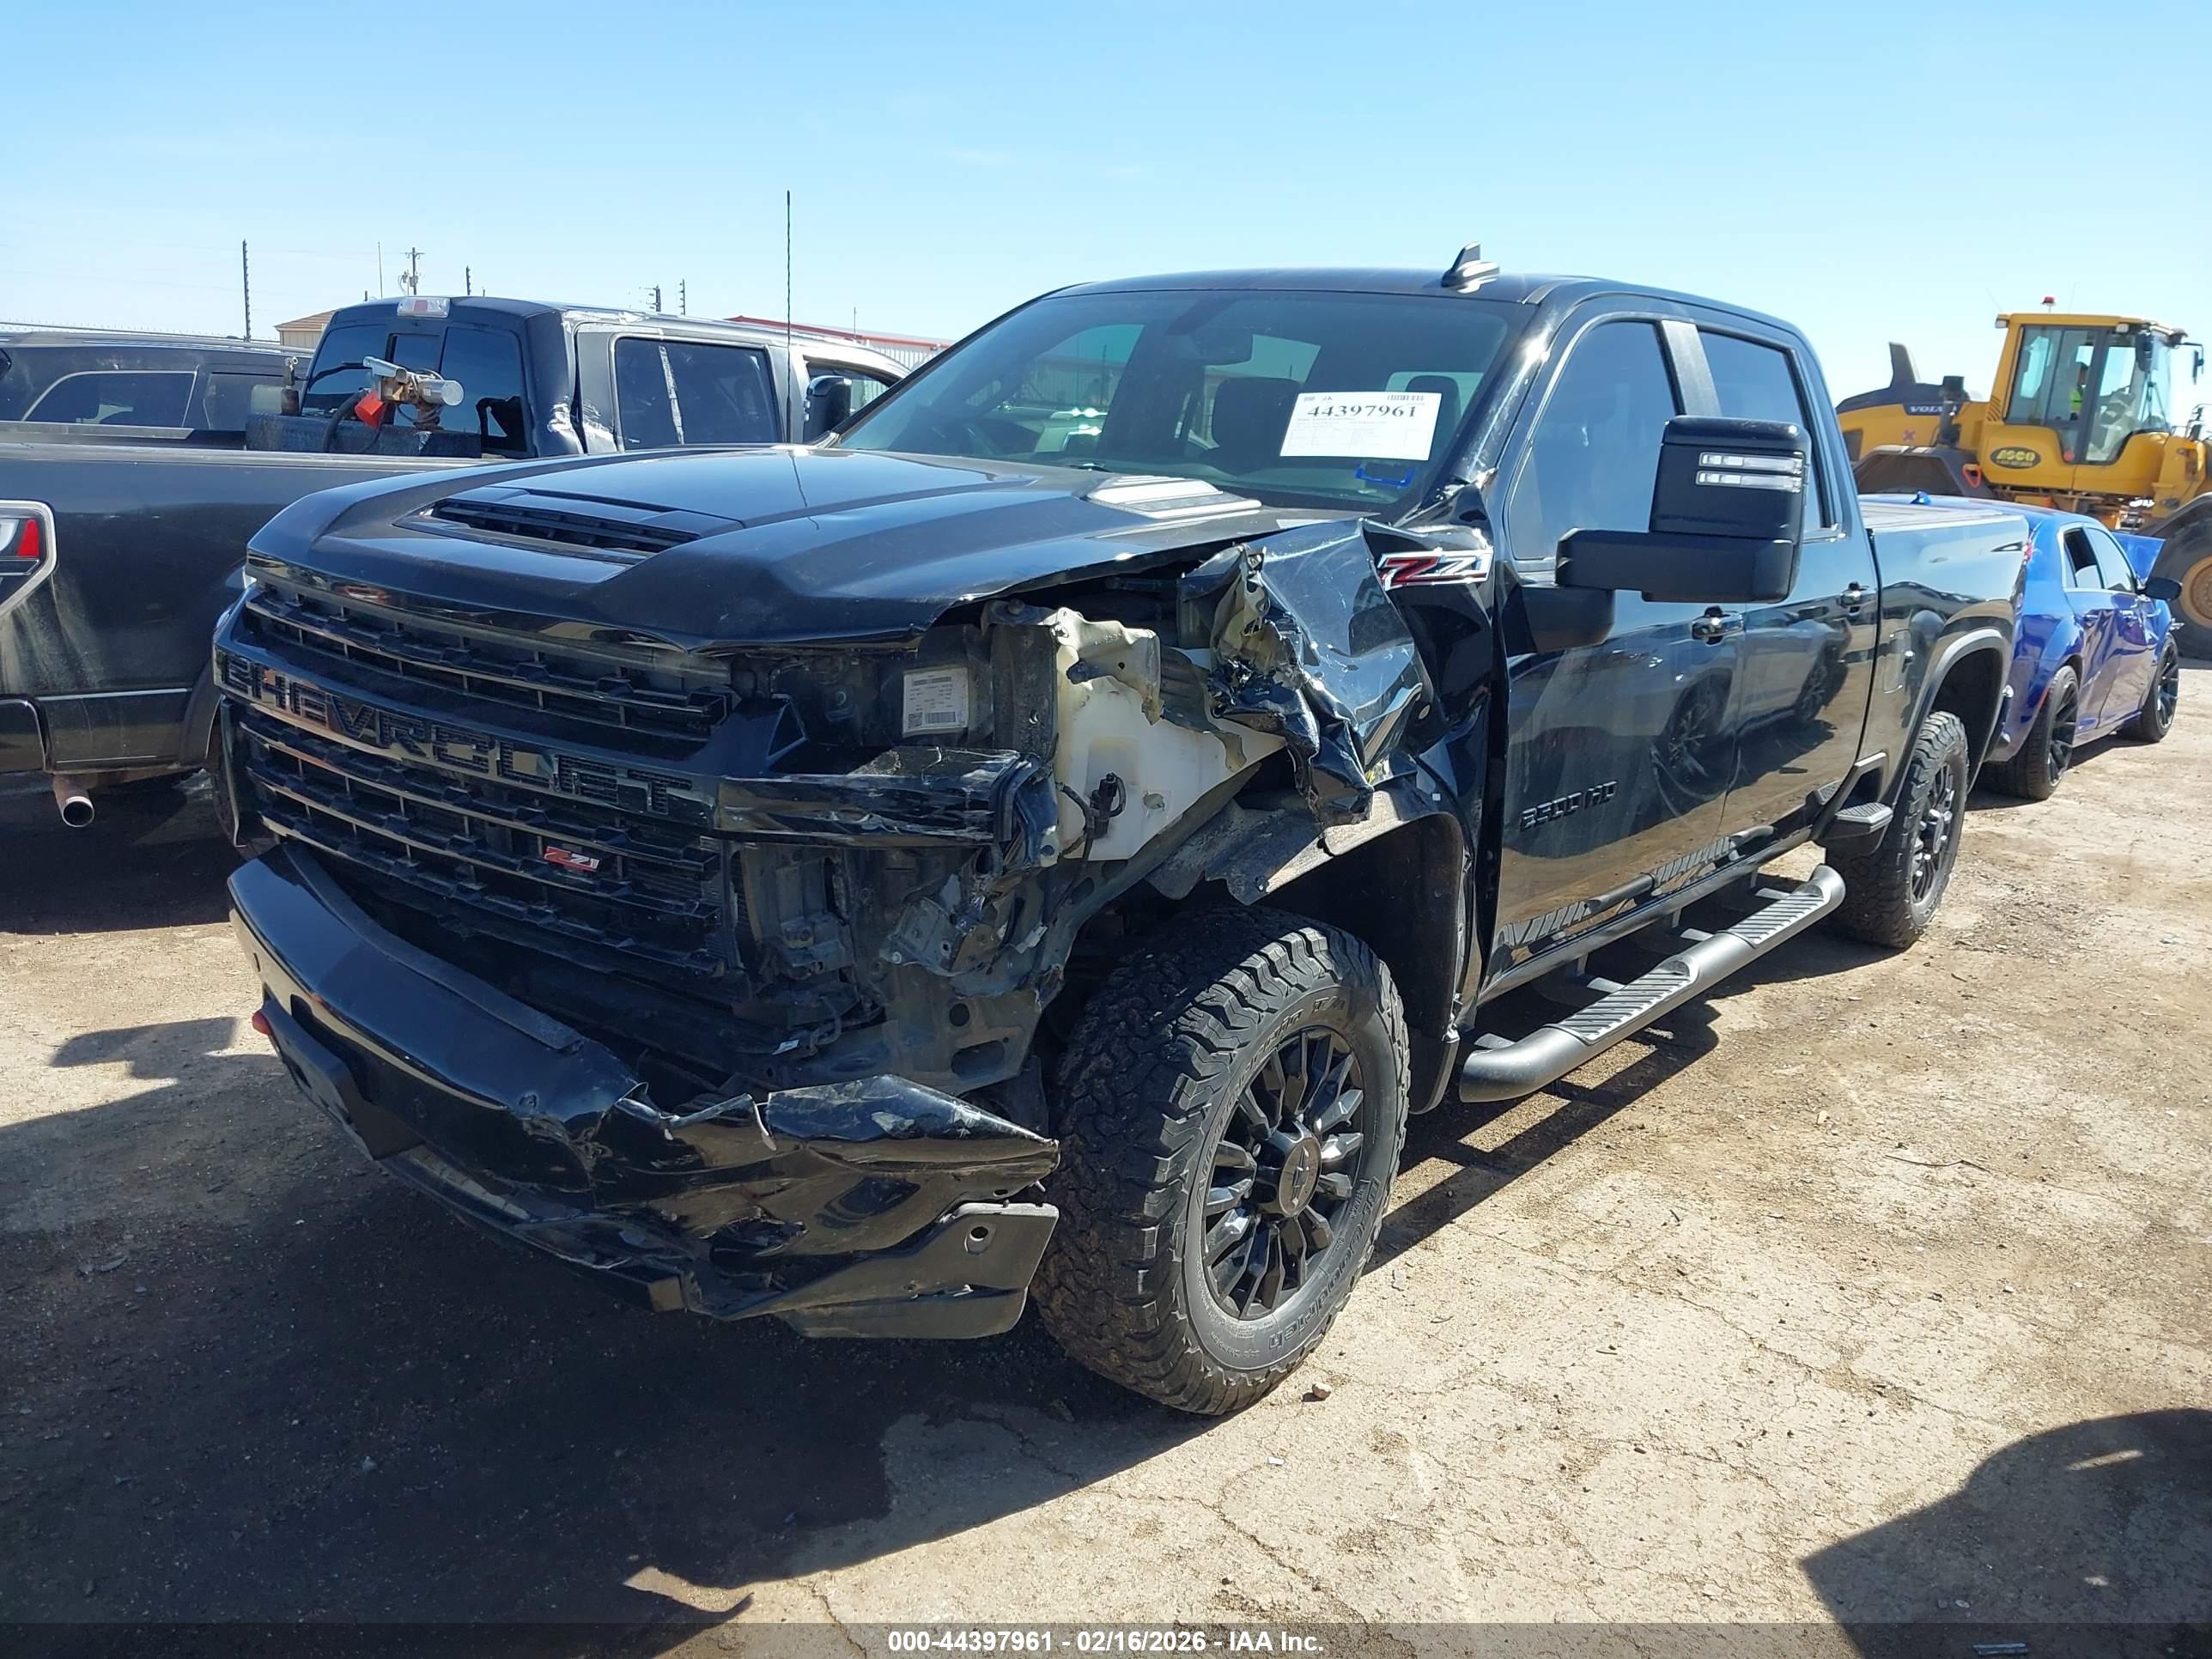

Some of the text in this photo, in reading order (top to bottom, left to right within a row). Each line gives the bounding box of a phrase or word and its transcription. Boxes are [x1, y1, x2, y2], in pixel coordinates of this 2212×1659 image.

[1307, 404, 1417, 418] 44397961
[1910, 405, 1958, 414] VOLV
[1996, 449, 2036, 462] ASCO
[221, 653, 692, 816] CHEVROLET
[1585, 780, 1618, 810] HD
